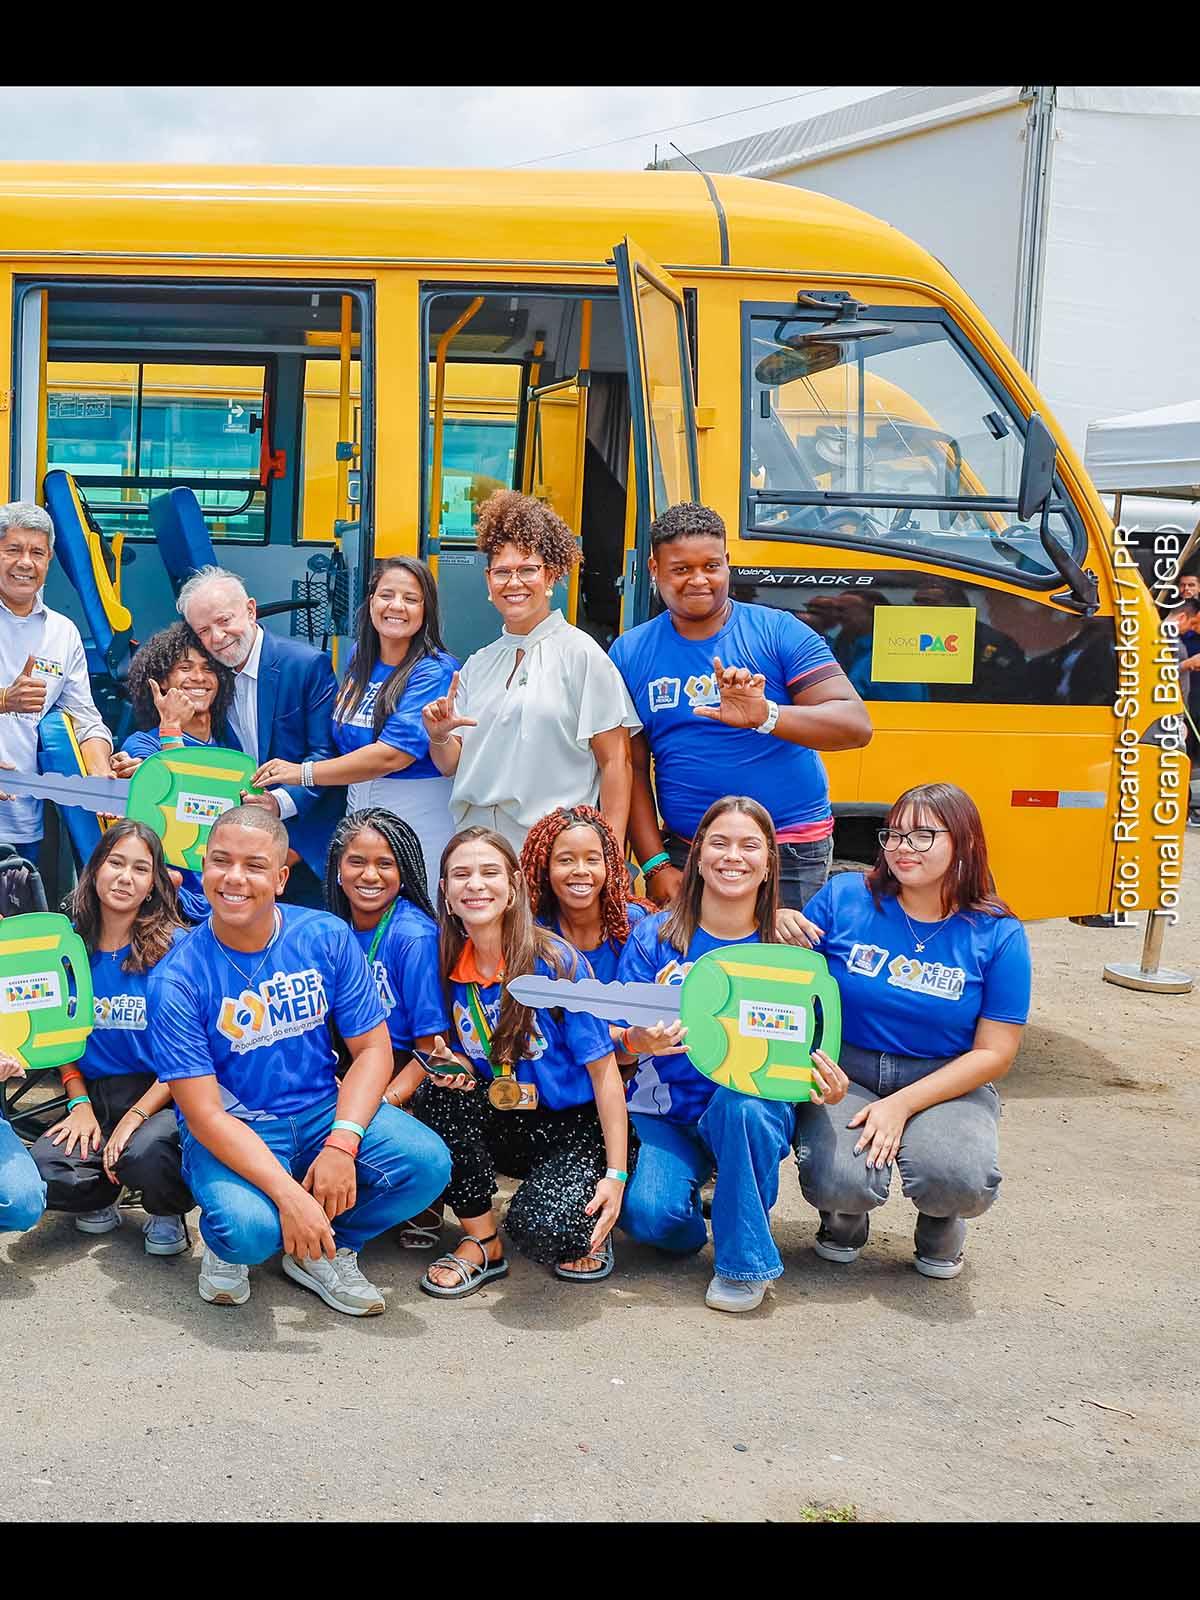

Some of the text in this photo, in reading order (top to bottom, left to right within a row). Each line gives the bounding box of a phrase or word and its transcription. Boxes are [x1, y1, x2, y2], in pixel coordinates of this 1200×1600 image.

[759, 574, 874, 585] ATTACK 8
[919, 633, 959, 652] PAC
[920, 974, 963, 991] MEIA
[6, 982, 54, 1002] BRASIL
[112, 1008, 146, 1022] MEIA
[267, 990, 327, 1027] MEIA
[747, 1012, 798, 1030] BRASIL
